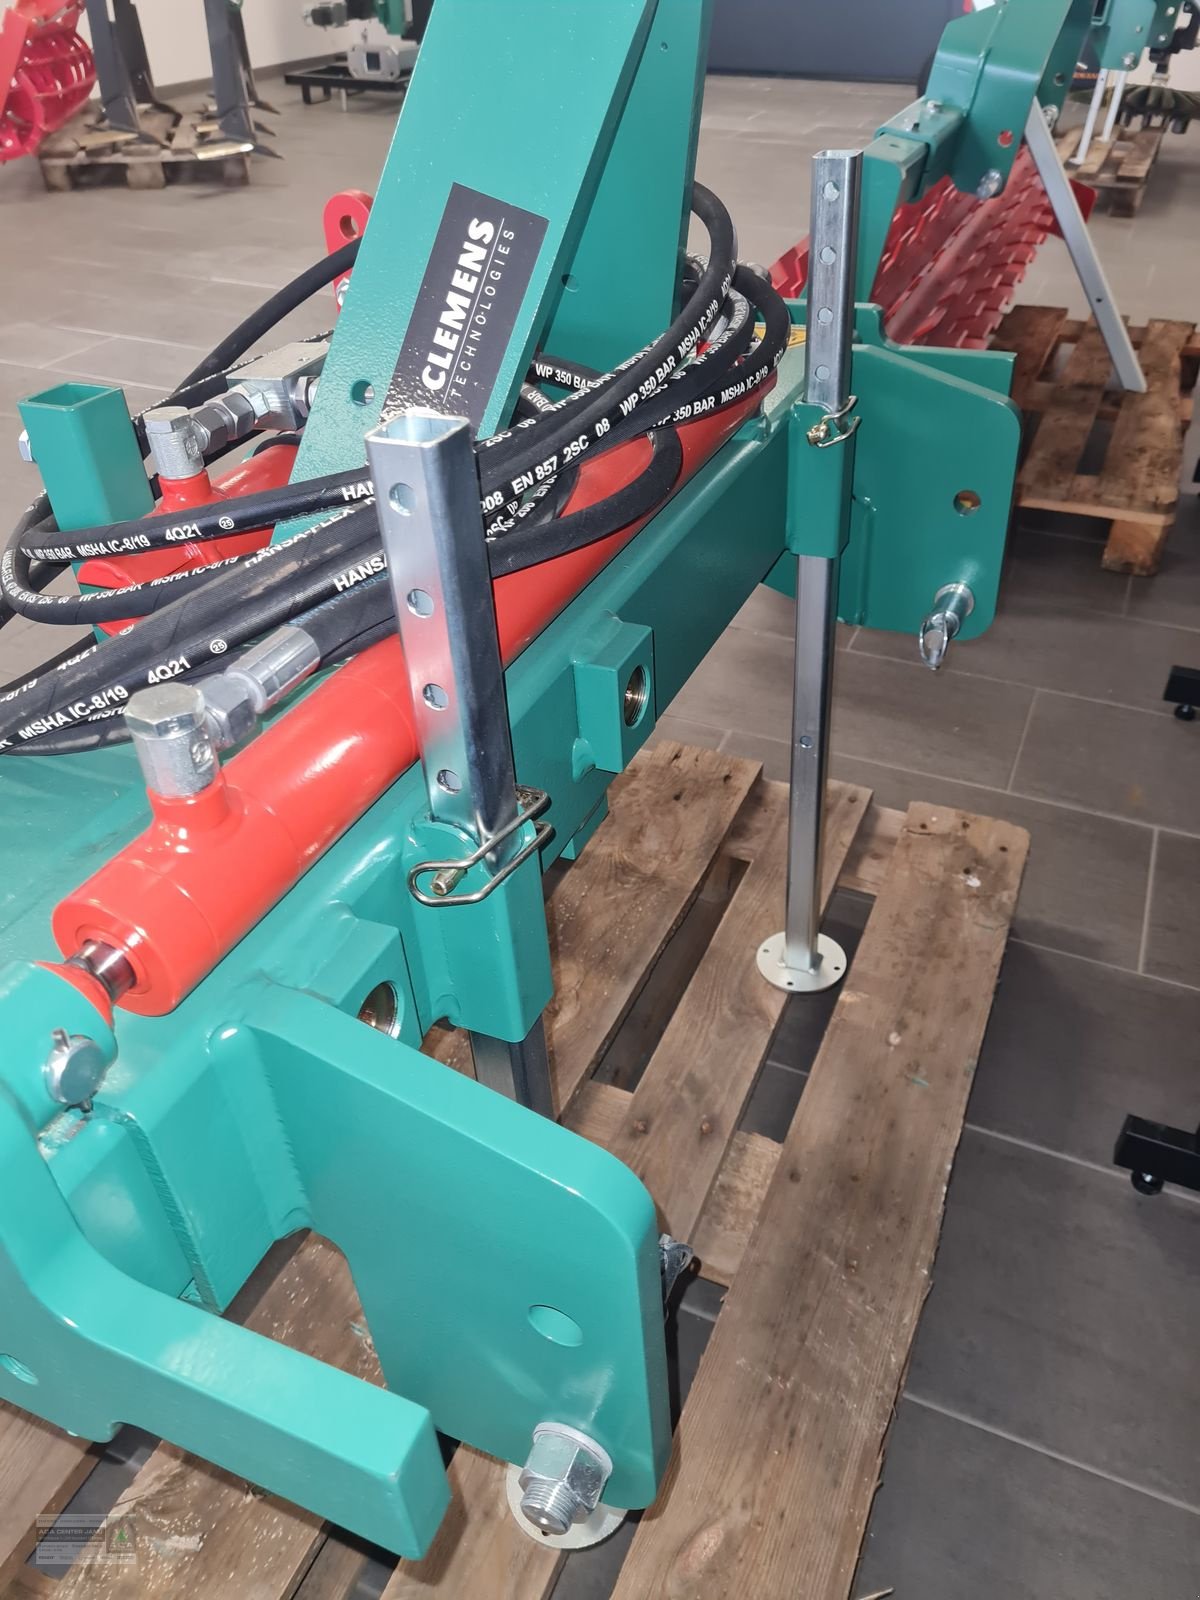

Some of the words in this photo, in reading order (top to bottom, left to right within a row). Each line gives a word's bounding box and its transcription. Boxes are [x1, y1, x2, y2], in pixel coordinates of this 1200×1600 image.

[421, 217, 495, 391] CLEMENS
[511, 471, 534, 495] EN
[534, 456, 558, 480] 857
[562, 434, 590, 464] 2SC
[595, 417, 611, 437] 08
[619, 392, 639, 416] WP
[638, 376, 657, 400] 350
[655, 355, 676, 383] BAR
[677, 326, 701, 358] MSHA
[535, 363, 554, 380] WP
[555, 369, 571, 386] 350
[693, 395, 716, 415] BAR
[720, 381, 746, 404] MSHA
[56, 546, 76, 560] BAR
[76, 542, 109, 558] MSHA
[108, 534, 151, 553] IC-8/19
[165, 523, 202, 542] 4Q21
[18, 712, 73, 740] MSHA
[68, 685, 129, 719] IC-8/19
[147, 656, 192, 684] 4Q21
[332, 553, 388, 592] HANS
